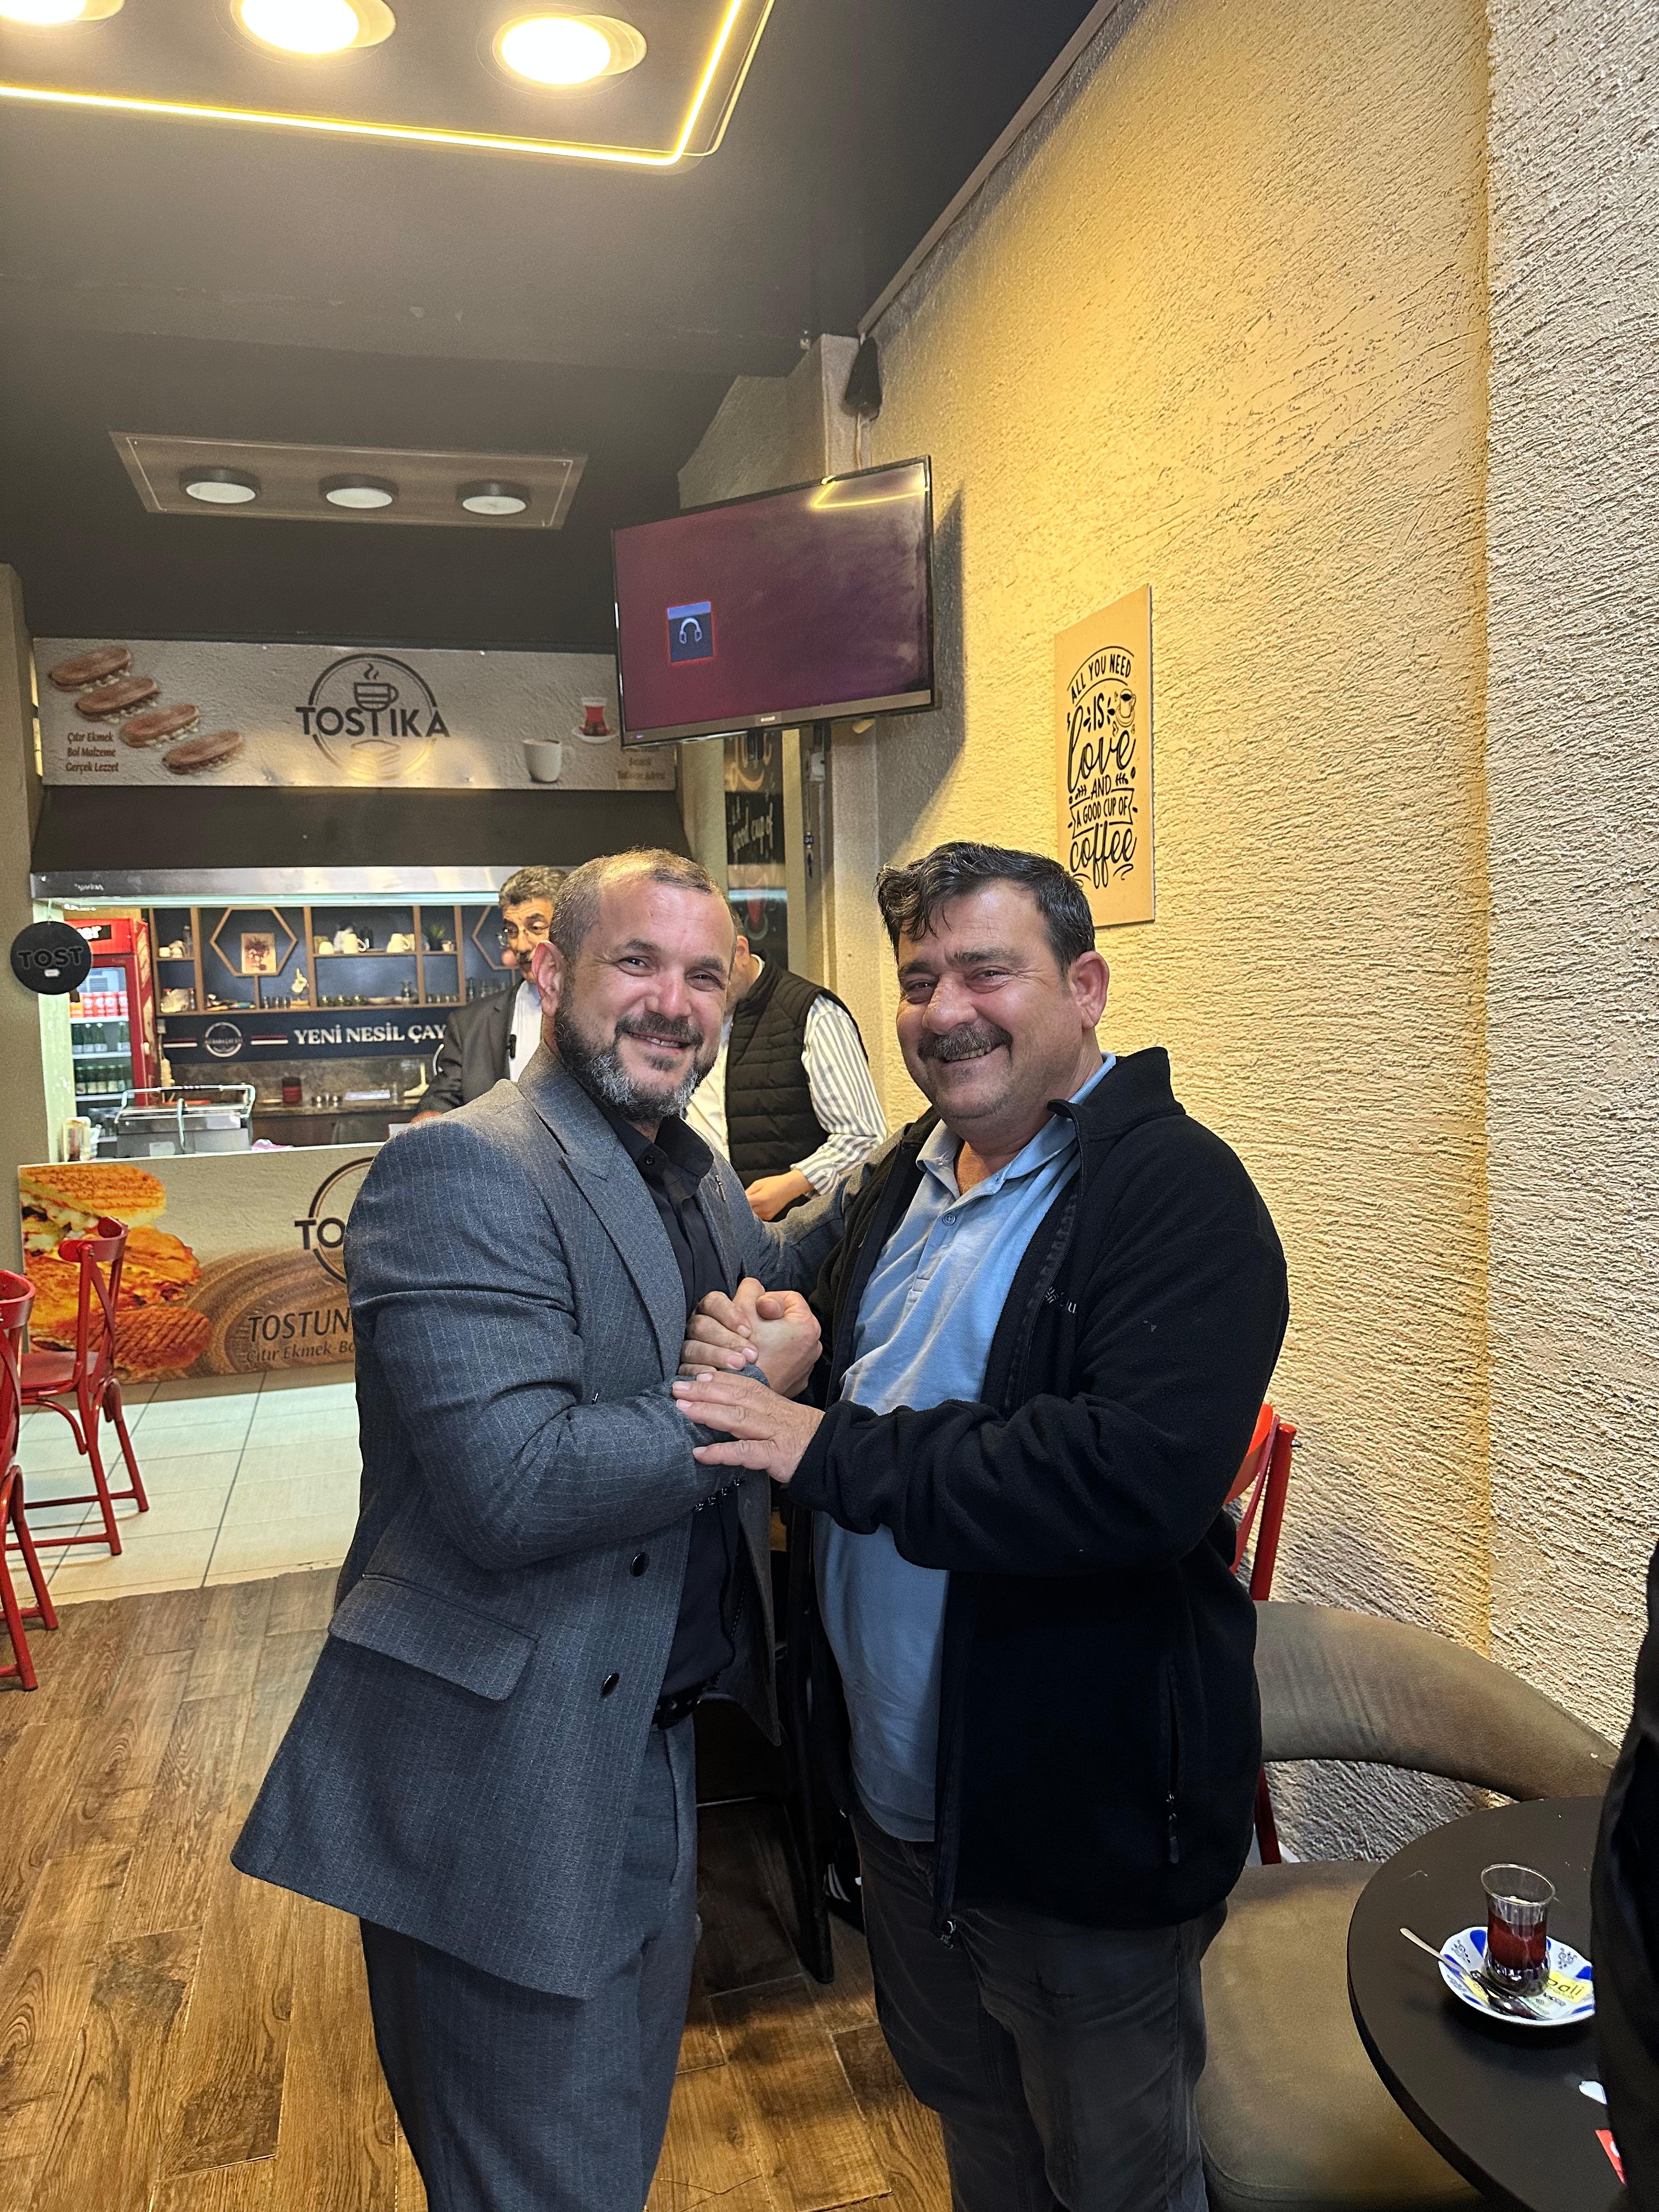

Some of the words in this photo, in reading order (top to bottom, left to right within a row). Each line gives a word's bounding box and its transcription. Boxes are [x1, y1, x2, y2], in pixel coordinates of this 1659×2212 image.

[1071, 673, 1086, 704] ALL
[1088, 655, 1107, 681] YOU
[1109, 653, 1131, 678] NEED
[295, 706, 451, 737] TOSTIKA
[1093, 692, 1104, 731] IS
[67, 747, 80, 757] Bol
[87, 731, 114, 742] Ekmek
[1067, 705, 1136, 793] love
[1091, 774, 1111, 800] AND
[1076, 810, 1081, 828] A
[1083, 801, 1102, 824] GOOD
[1103, 797, 1116, 817] CUP
[1119, 796, 1128, 816] OF
[1069, 821, 1137, 889] coffee
[17, 946, 83, 969] TOST
[294, 1024, 342, 1045] YENİ
[346, 1022, 405, 1042] NESİL
[249, 1308, 351, 1342] TOSTUN
[283, 1341, 331, 1359] Ekmek
